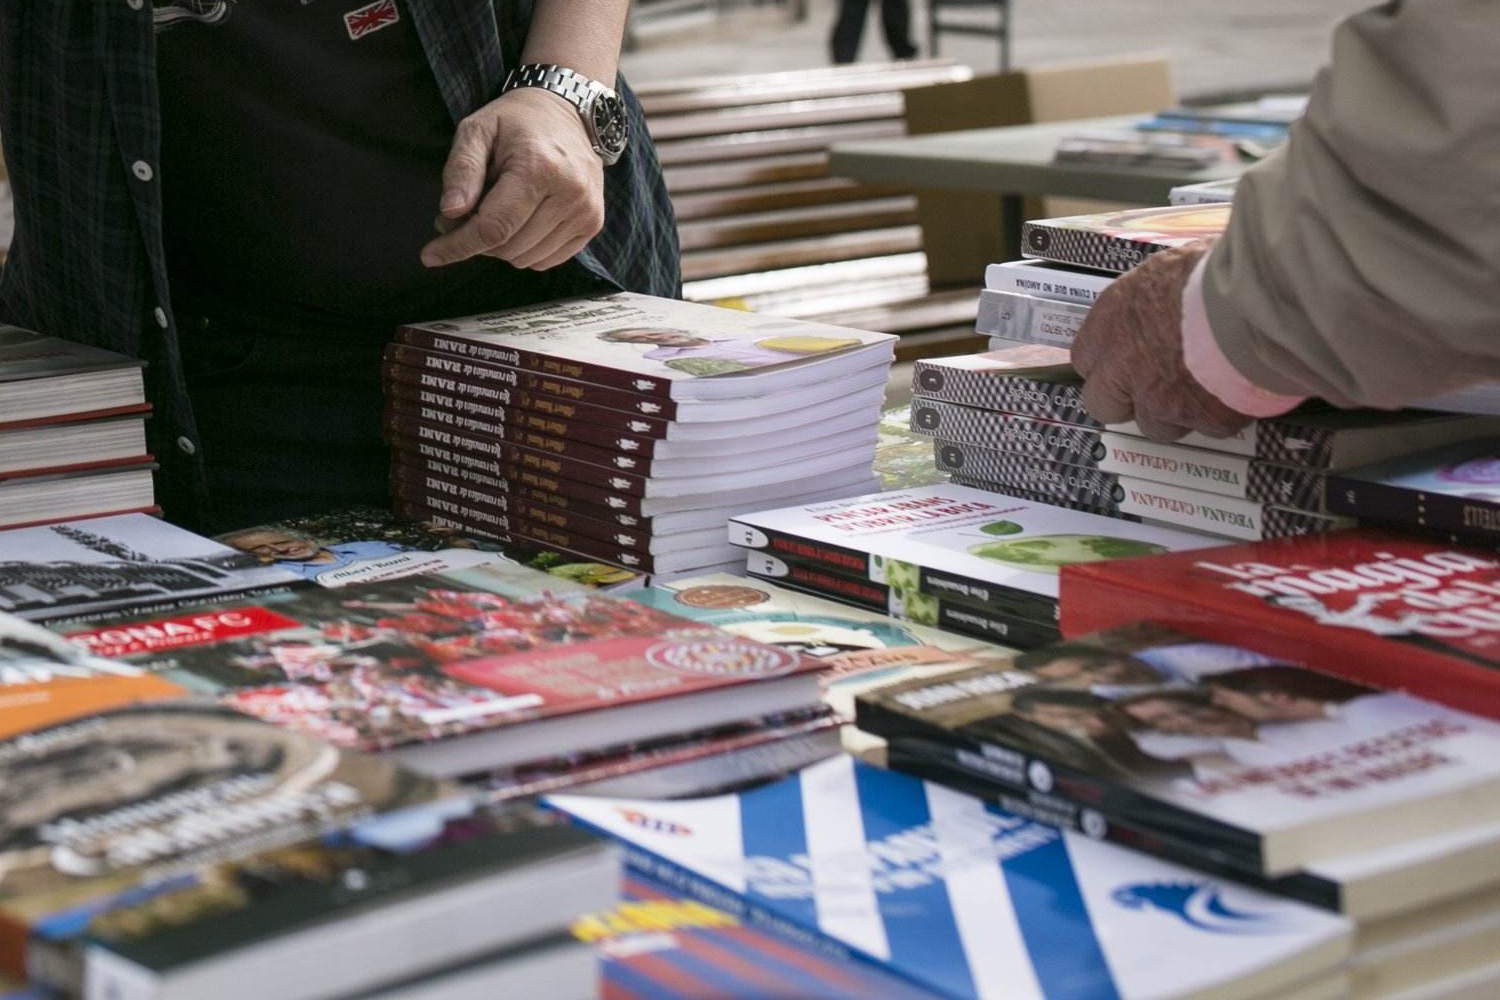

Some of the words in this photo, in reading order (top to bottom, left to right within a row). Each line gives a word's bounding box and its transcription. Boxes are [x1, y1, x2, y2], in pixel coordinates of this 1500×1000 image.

[1043, 281, 1052, 292] NO
[1054, 284, 1068, 296] QUE
[1069, 287, 1090, 299] CUINA
[432, 337, 467, 353] RAMI
[425, 355, 461, 373] RAMI
[420, 373, 455, 391] RAMI
[419, 389, 453, 408] RAMI
[420, 406, 454, 424] RAMI
[418, 425, 451, 444] RAMI
[418, 442, 451, 461] RAMI
[1112, 449, 1178, 473] CATALANA
[1185, 463, 1240, 485] VEGANA
[1131, 490, 1195, 515] CATALANA
[1201, 507, 1255, 530] VEGANA
[66, 621, 197, 649] RONA
[193, 612, 251, 631] FC
